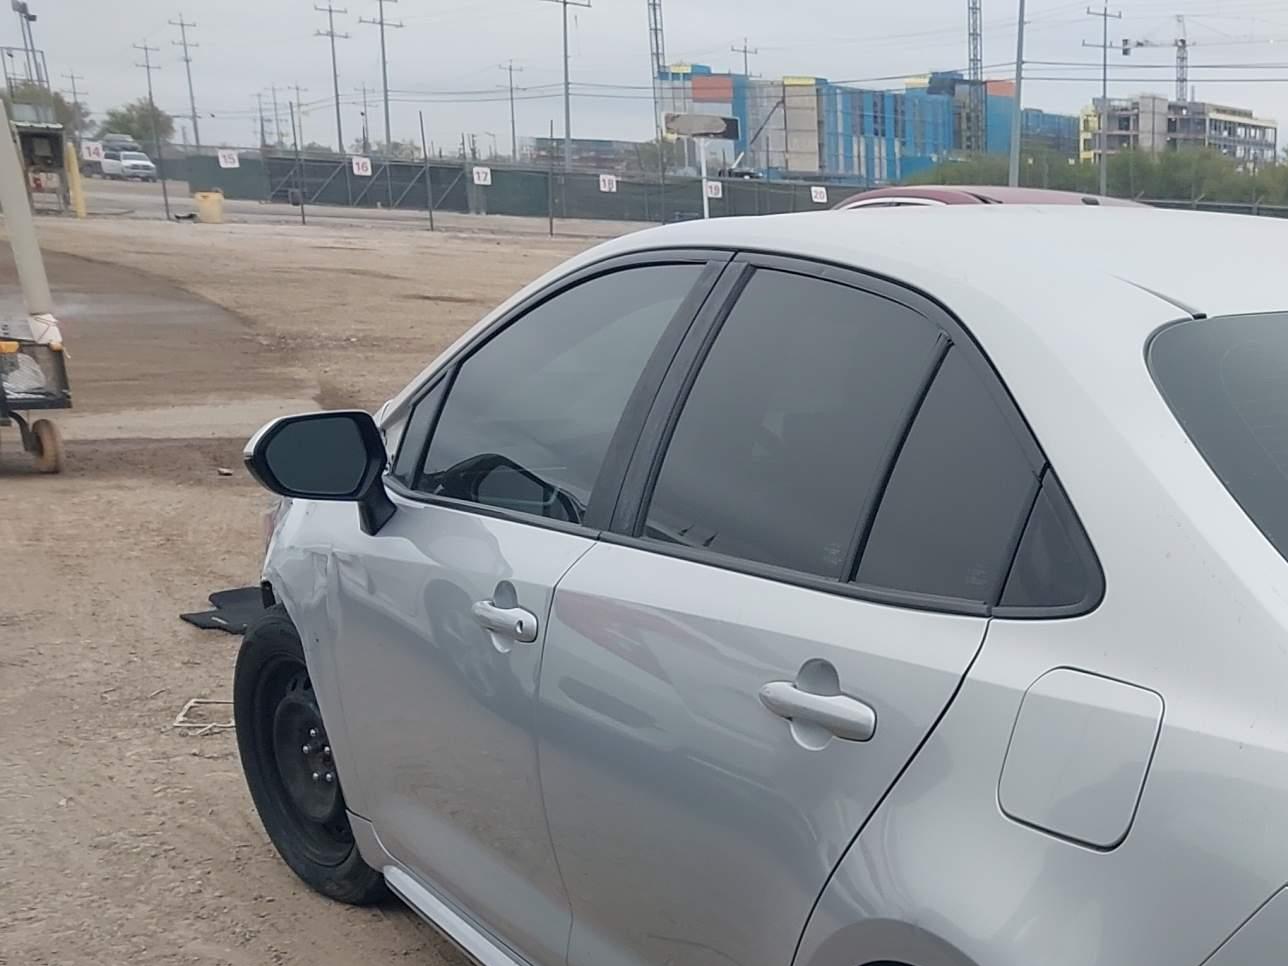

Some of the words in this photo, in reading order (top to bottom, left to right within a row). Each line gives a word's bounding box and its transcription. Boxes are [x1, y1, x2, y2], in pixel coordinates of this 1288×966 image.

[85, 146, 101, 158] 14
[222, 153, 236, 165] 15
[354, 161, 369, 173] 16
[475, 170, 489, 182] 17
[708, 184, 721, 196] 19
[813, 189, 826, 200] 20
